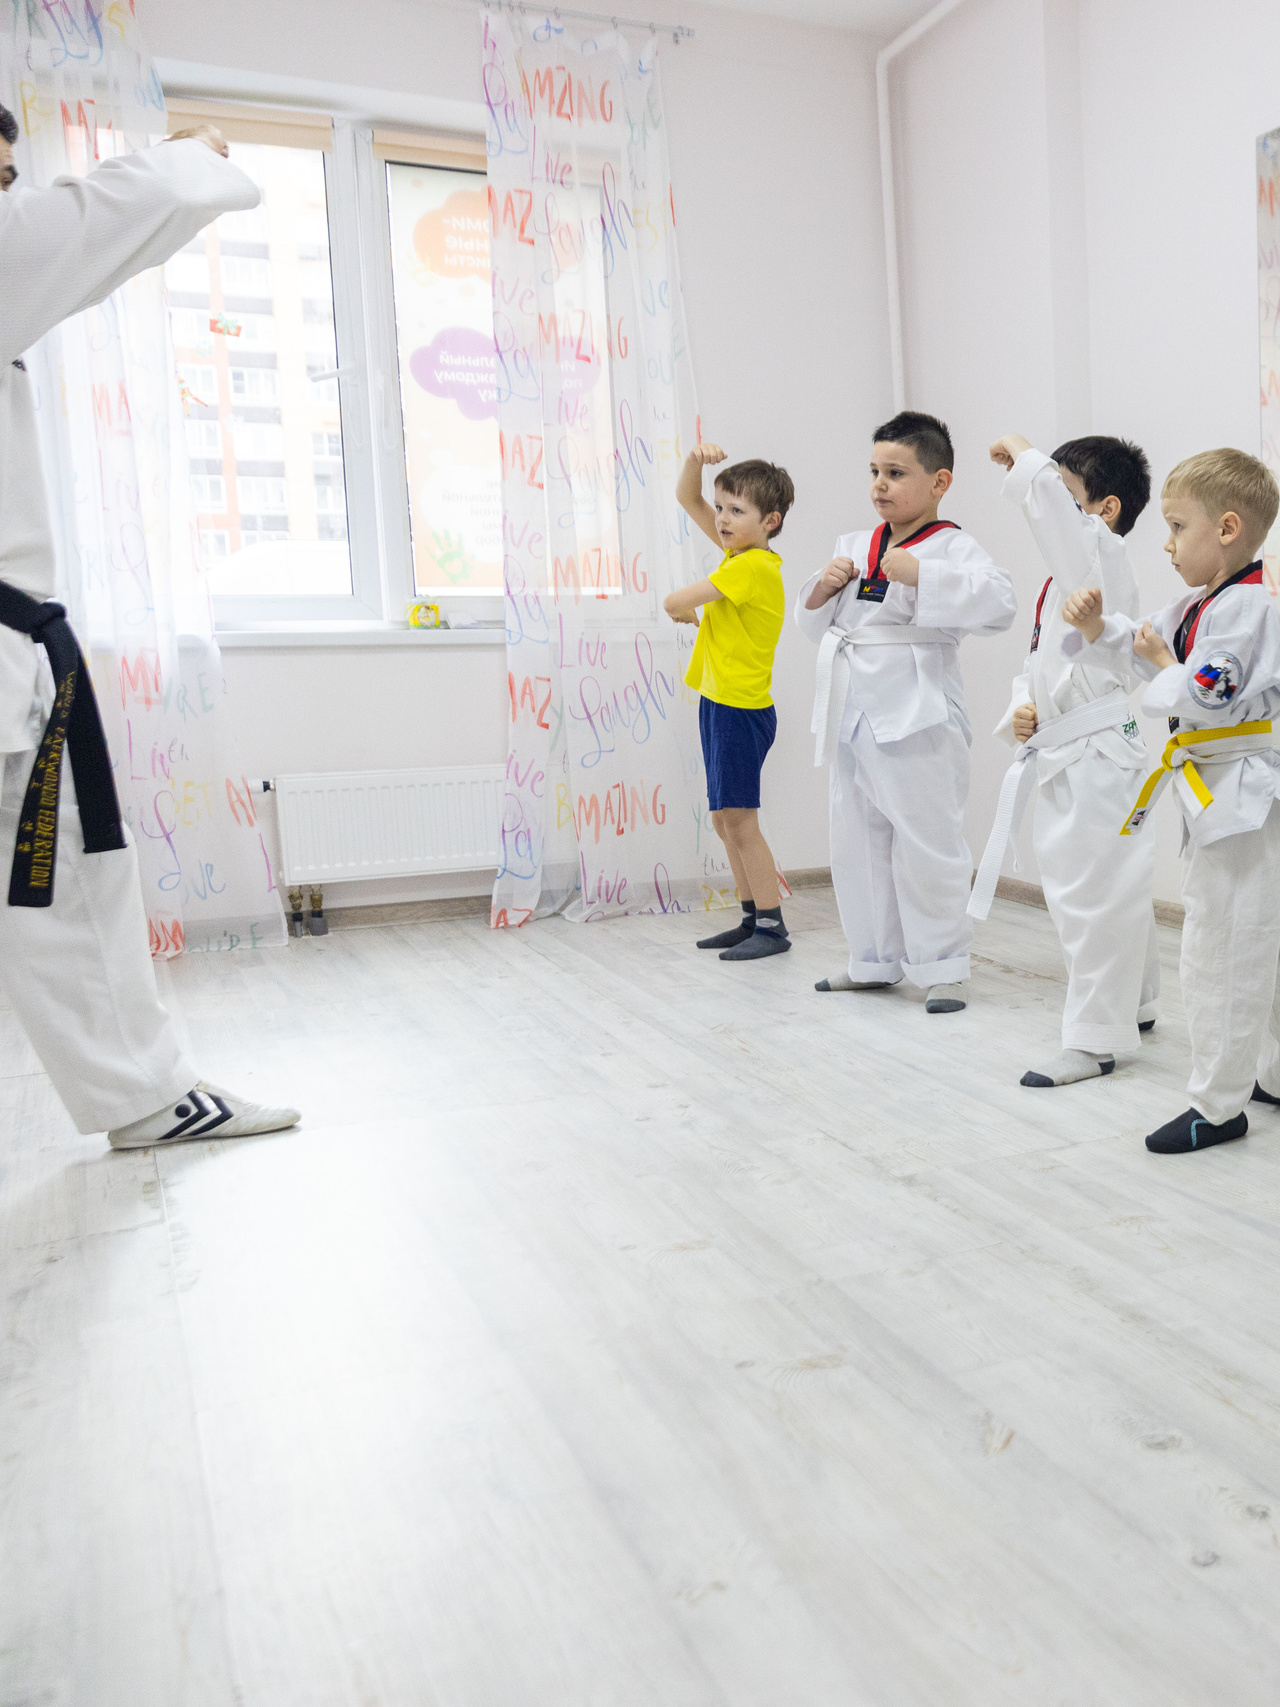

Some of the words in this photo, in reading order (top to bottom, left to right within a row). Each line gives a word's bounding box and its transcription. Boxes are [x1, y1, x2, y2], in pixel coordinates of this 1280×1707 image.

[568, 631, 674, 768] Laugh
[40, 726, 66, 807] TAEKWONDO
[29, 809, 56, 888] FEDERATION
[580, 850, 628, 906] Live
